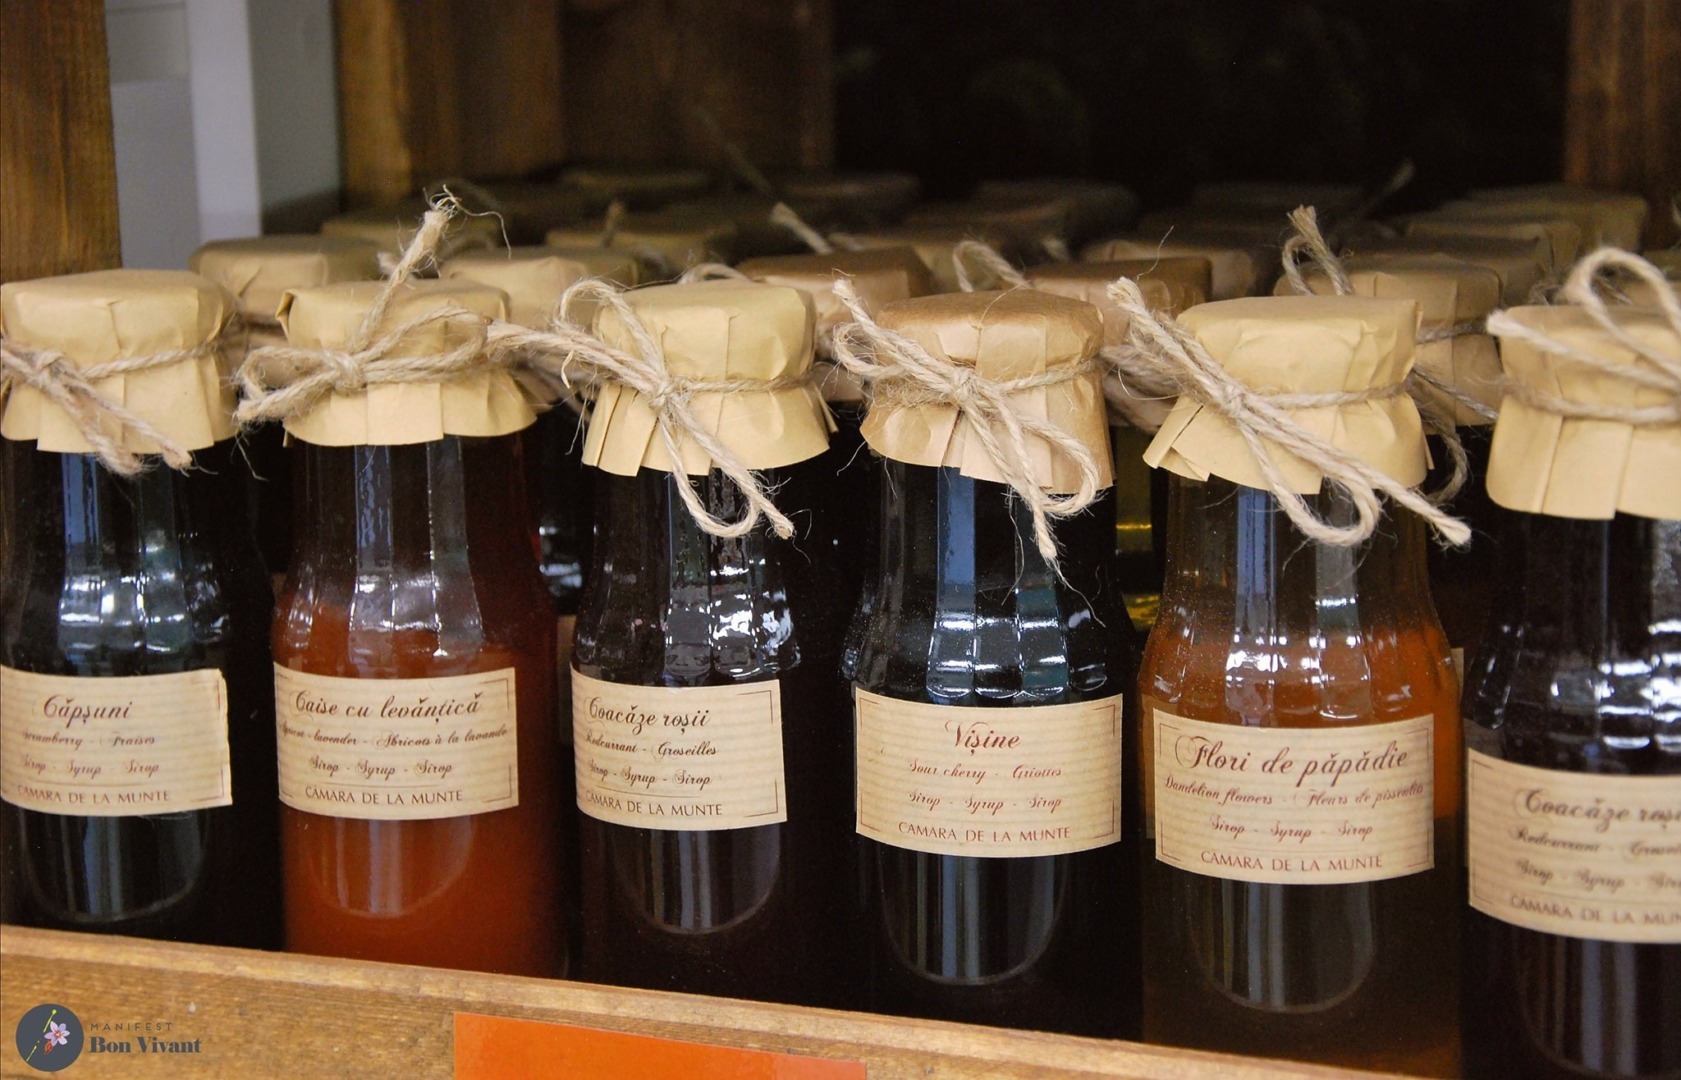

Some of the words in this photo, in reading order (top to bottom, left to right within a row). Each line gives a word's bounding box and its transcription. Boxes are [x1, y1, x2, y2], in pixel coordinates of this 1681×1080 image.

[346, 705, 370, 718] cu
[586, 696, 657, 735] Coacăze
[663, 709, 710, 735] roșii
[313, 728, 358, 745] lavender
[448, 731, 460, 744] la
[464, 724, 508, 743] lavande
[945, 720, 1020, 755] Vișine
[653, 741, 717, 758] Groseilles
[125, 759, 159, 777] Sirop
[309, 755, 339, 777] Sirop
[356, 759, 396, 781] Syrup
[415, 759, 452, 778] Sirop
[909, 758, 938, 775] Sour
[943, 760, 986, 784] cherry
[1175, 735, 1251, 772] Flori
[1261, 747, 1293, 774] de
[1296, 740, 1407, 787] păpădie
[587, 759, 609, 782] Sirop
[621, 766, 656, 789] Syrup
[673, 769, 711, 790] Sirop
[69, 791, 85, 804] DE
[93, 791, 110, 804] LA
[118, 790, 170, 804] MUNTE
[362, 792, 379, 804] DE
[387, 793, 404, 805] LA
[412, 790, 463, 804] MUNTE
[1165, 775, 1220, 799] Dandelion
[1219, 788, 1273, 806] flowers
[1302, 788, 1348, 807] Fleurs
[1355, 788, 1370, 803] de
[627, 800, 642, 814] DE
[649, 803, 664, 816] LA
[672, 803, 722, 816] MUNTE
[908, 791, 940, 811] Sirop
[964, 794, 1003, 815] Syrup
[1029, 793, 1062, 813] Sirop
[966, 829, 984, 842] DE
[994, 830, 1011, 842] LA
[1020, 827, 1070, 842] MUNTE
[1211, 815, 1245, 839] Sirop
[1270, 820, 1312, 844] Syrup
[1337, 820, 1373, 841] Sirop
[1272, 858, 1291, 871] DE
[1301, 858, 1320, 872] LA
[1328, 855, 1382, 871] MUNTE
[1582, 908, 1602, 922] DE
[1613, 910, 1635, 924] LA
